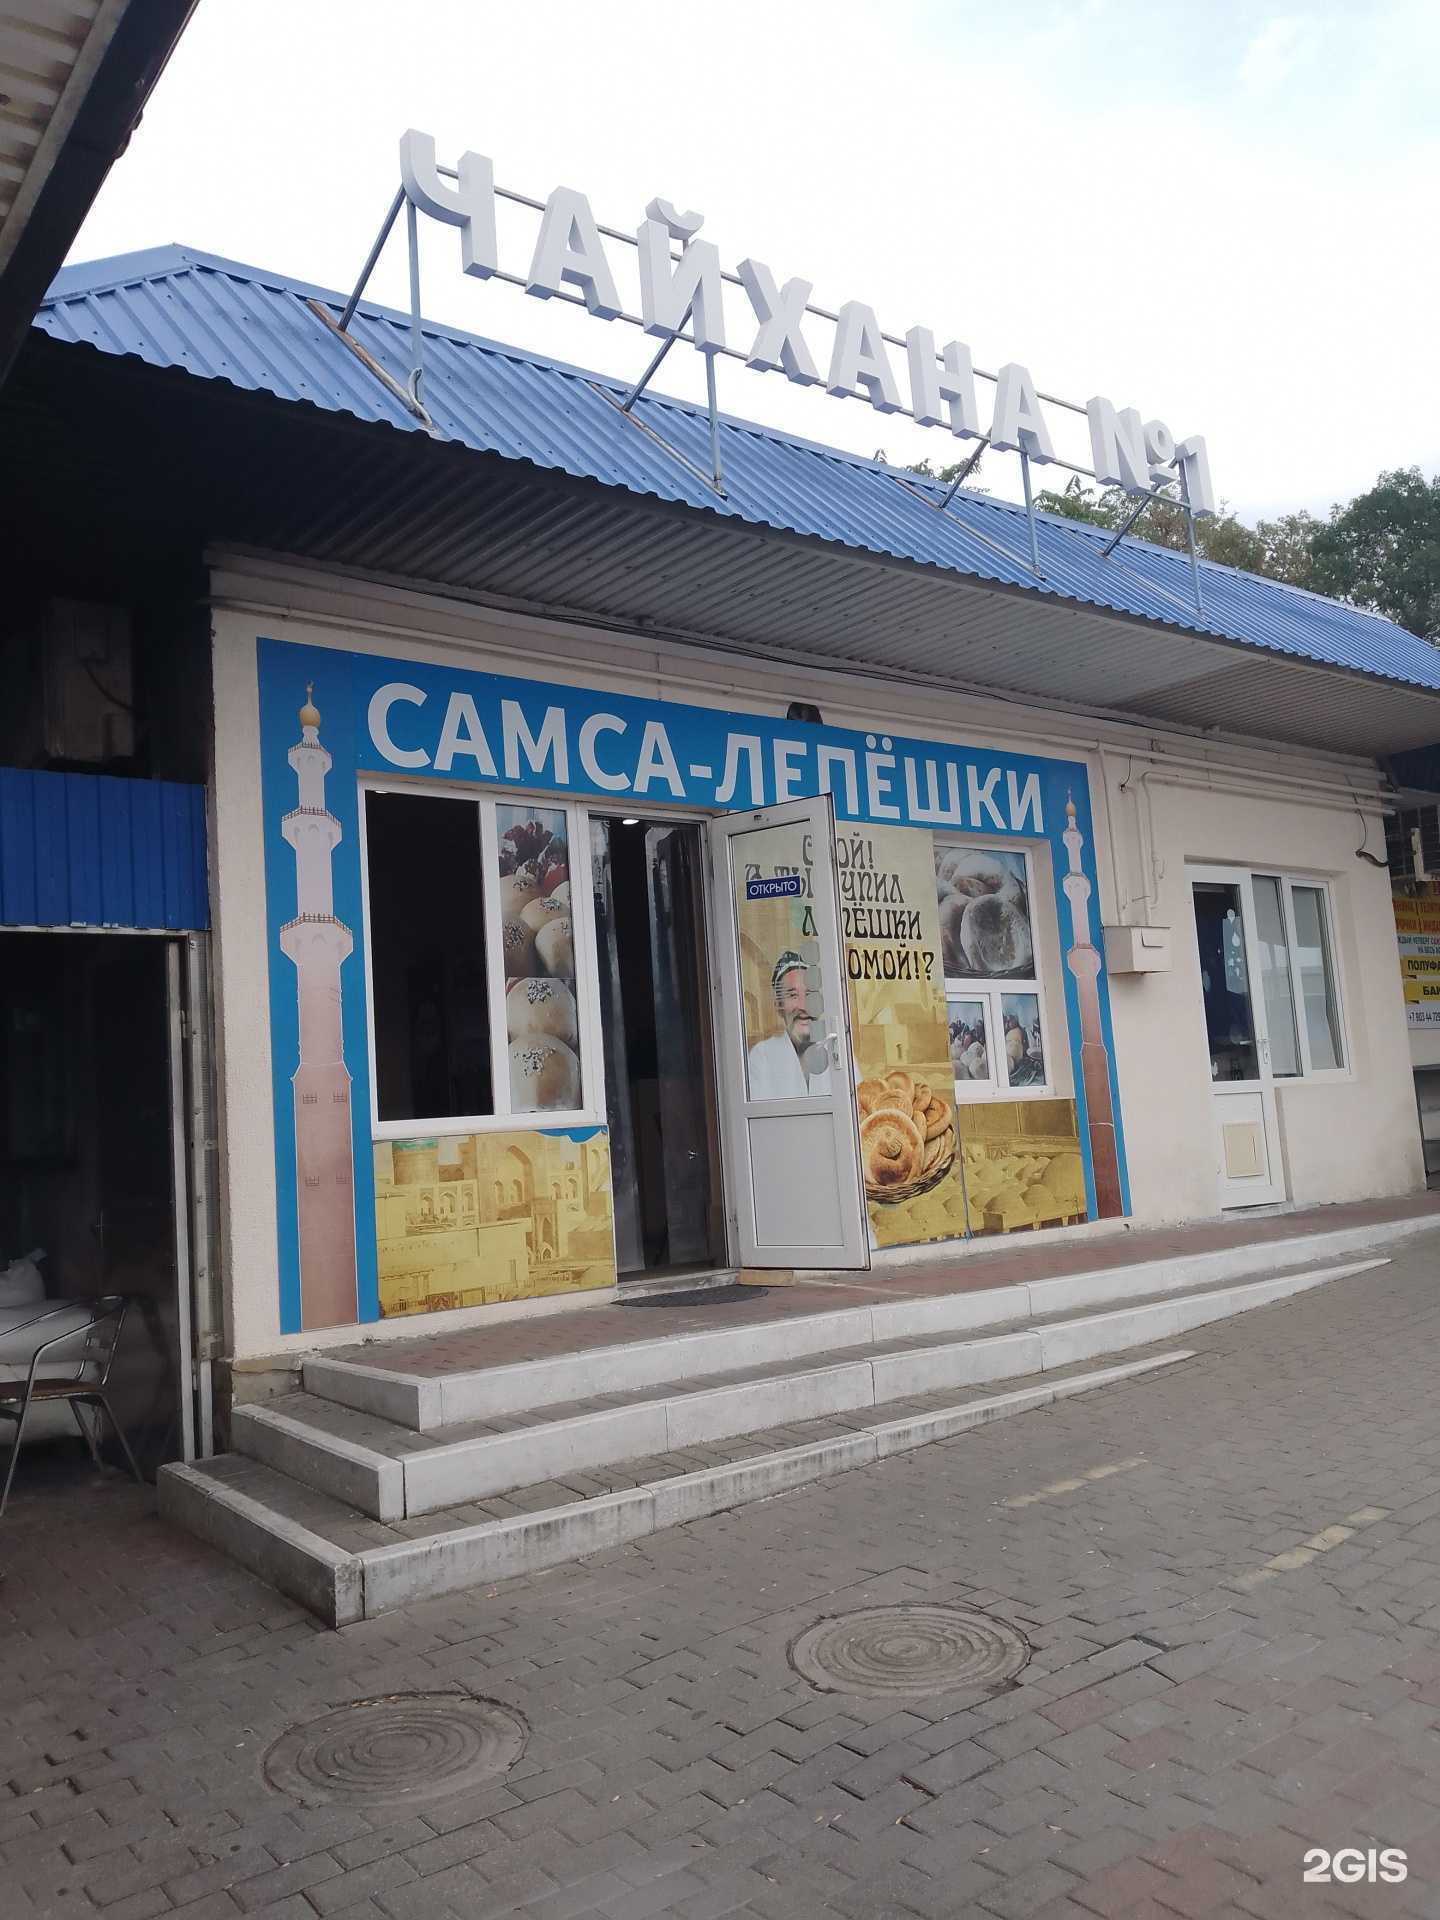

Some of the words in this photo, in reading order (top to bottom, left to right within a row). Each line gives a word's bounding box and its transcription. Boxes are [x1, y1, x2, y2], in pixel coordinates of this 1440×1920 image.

[400, 128, 1055, 466] ЧАЙХАНА
[367, 682, 1046, 834] САМСА-ЛЕПЁШКИ
[802, 831, 874, 870] СОЙ!
[749, 881, 798, 896] ОТКРЫТО
[840, 870, 905, 904] УПИЛ
[801, 902, 923, 941] ЛЁШКИ
[847, 943, 935, 981] ОМОЙ!?
